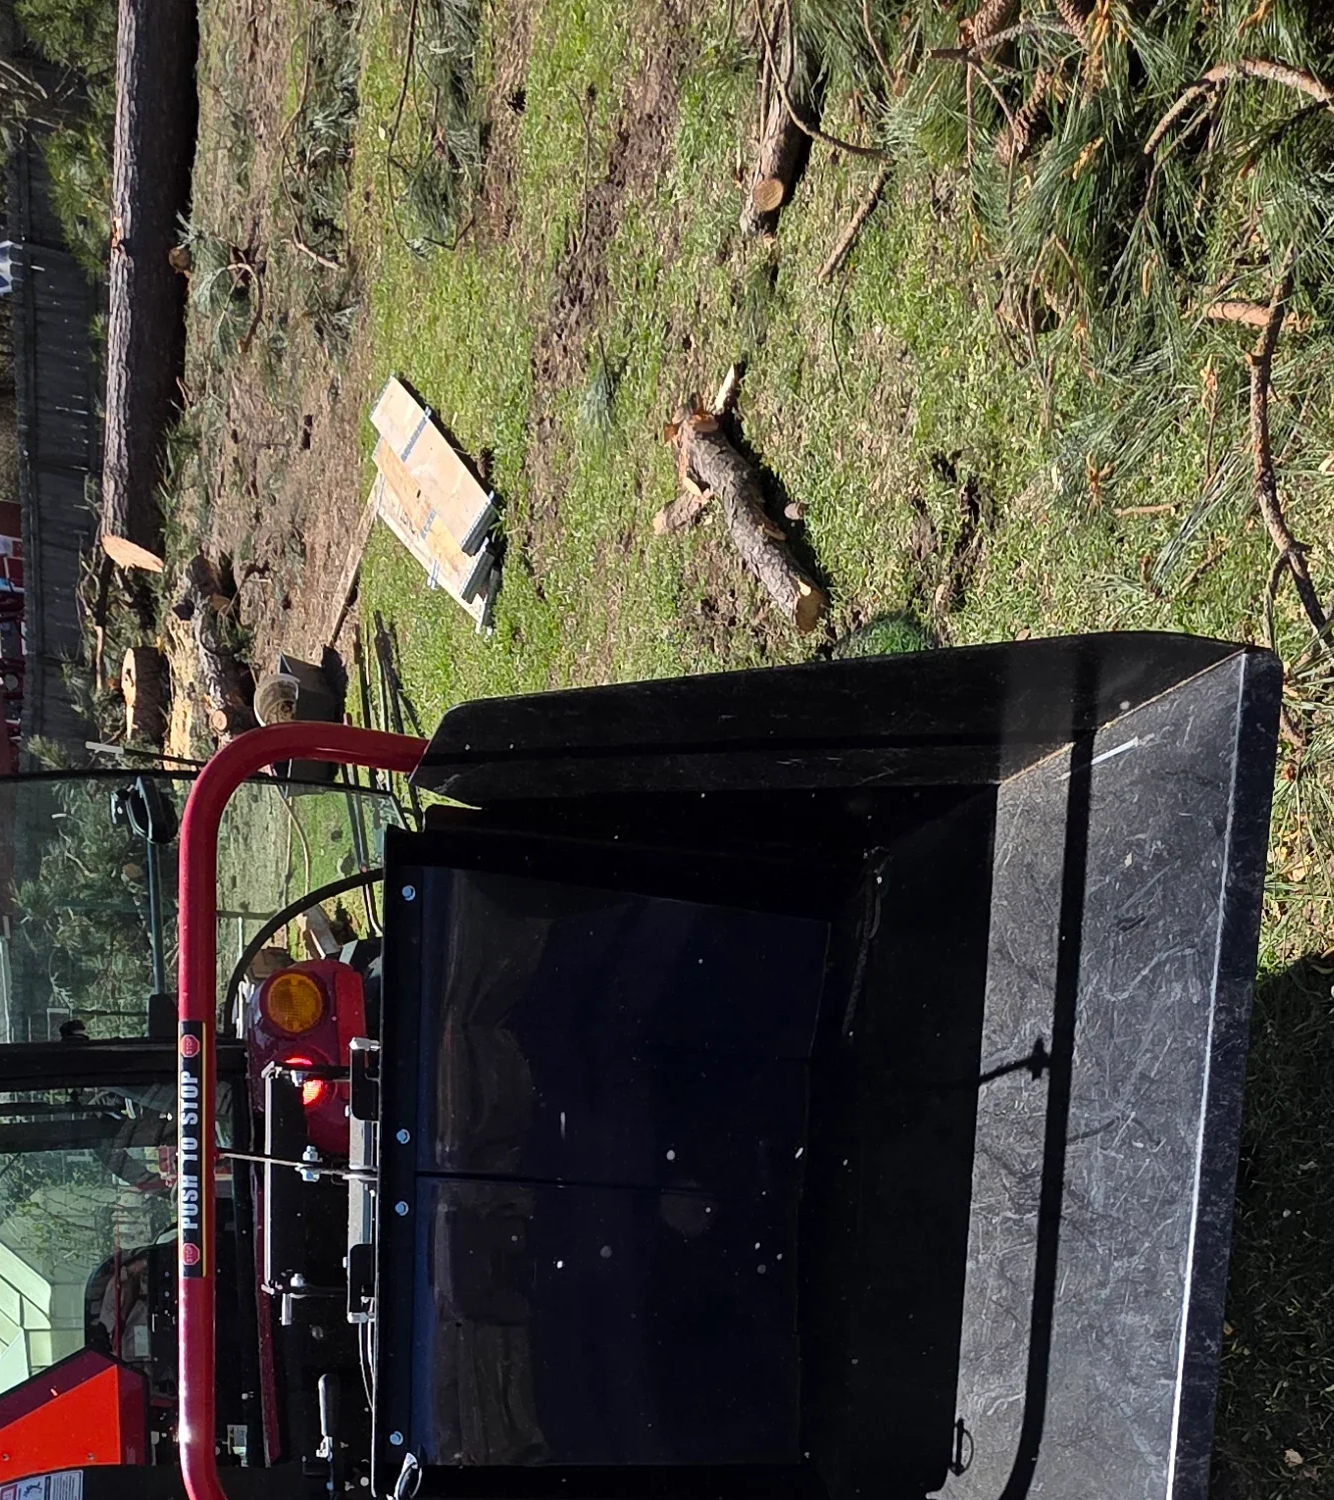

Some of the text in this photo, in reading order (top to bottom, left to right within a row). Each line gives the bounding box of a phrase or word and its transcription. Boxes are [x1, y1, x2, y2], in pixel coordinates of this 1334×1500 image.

[180, 1071, 198, 1229] PUSH TO STOP
[186, 1246, 194, 1263] STOP
